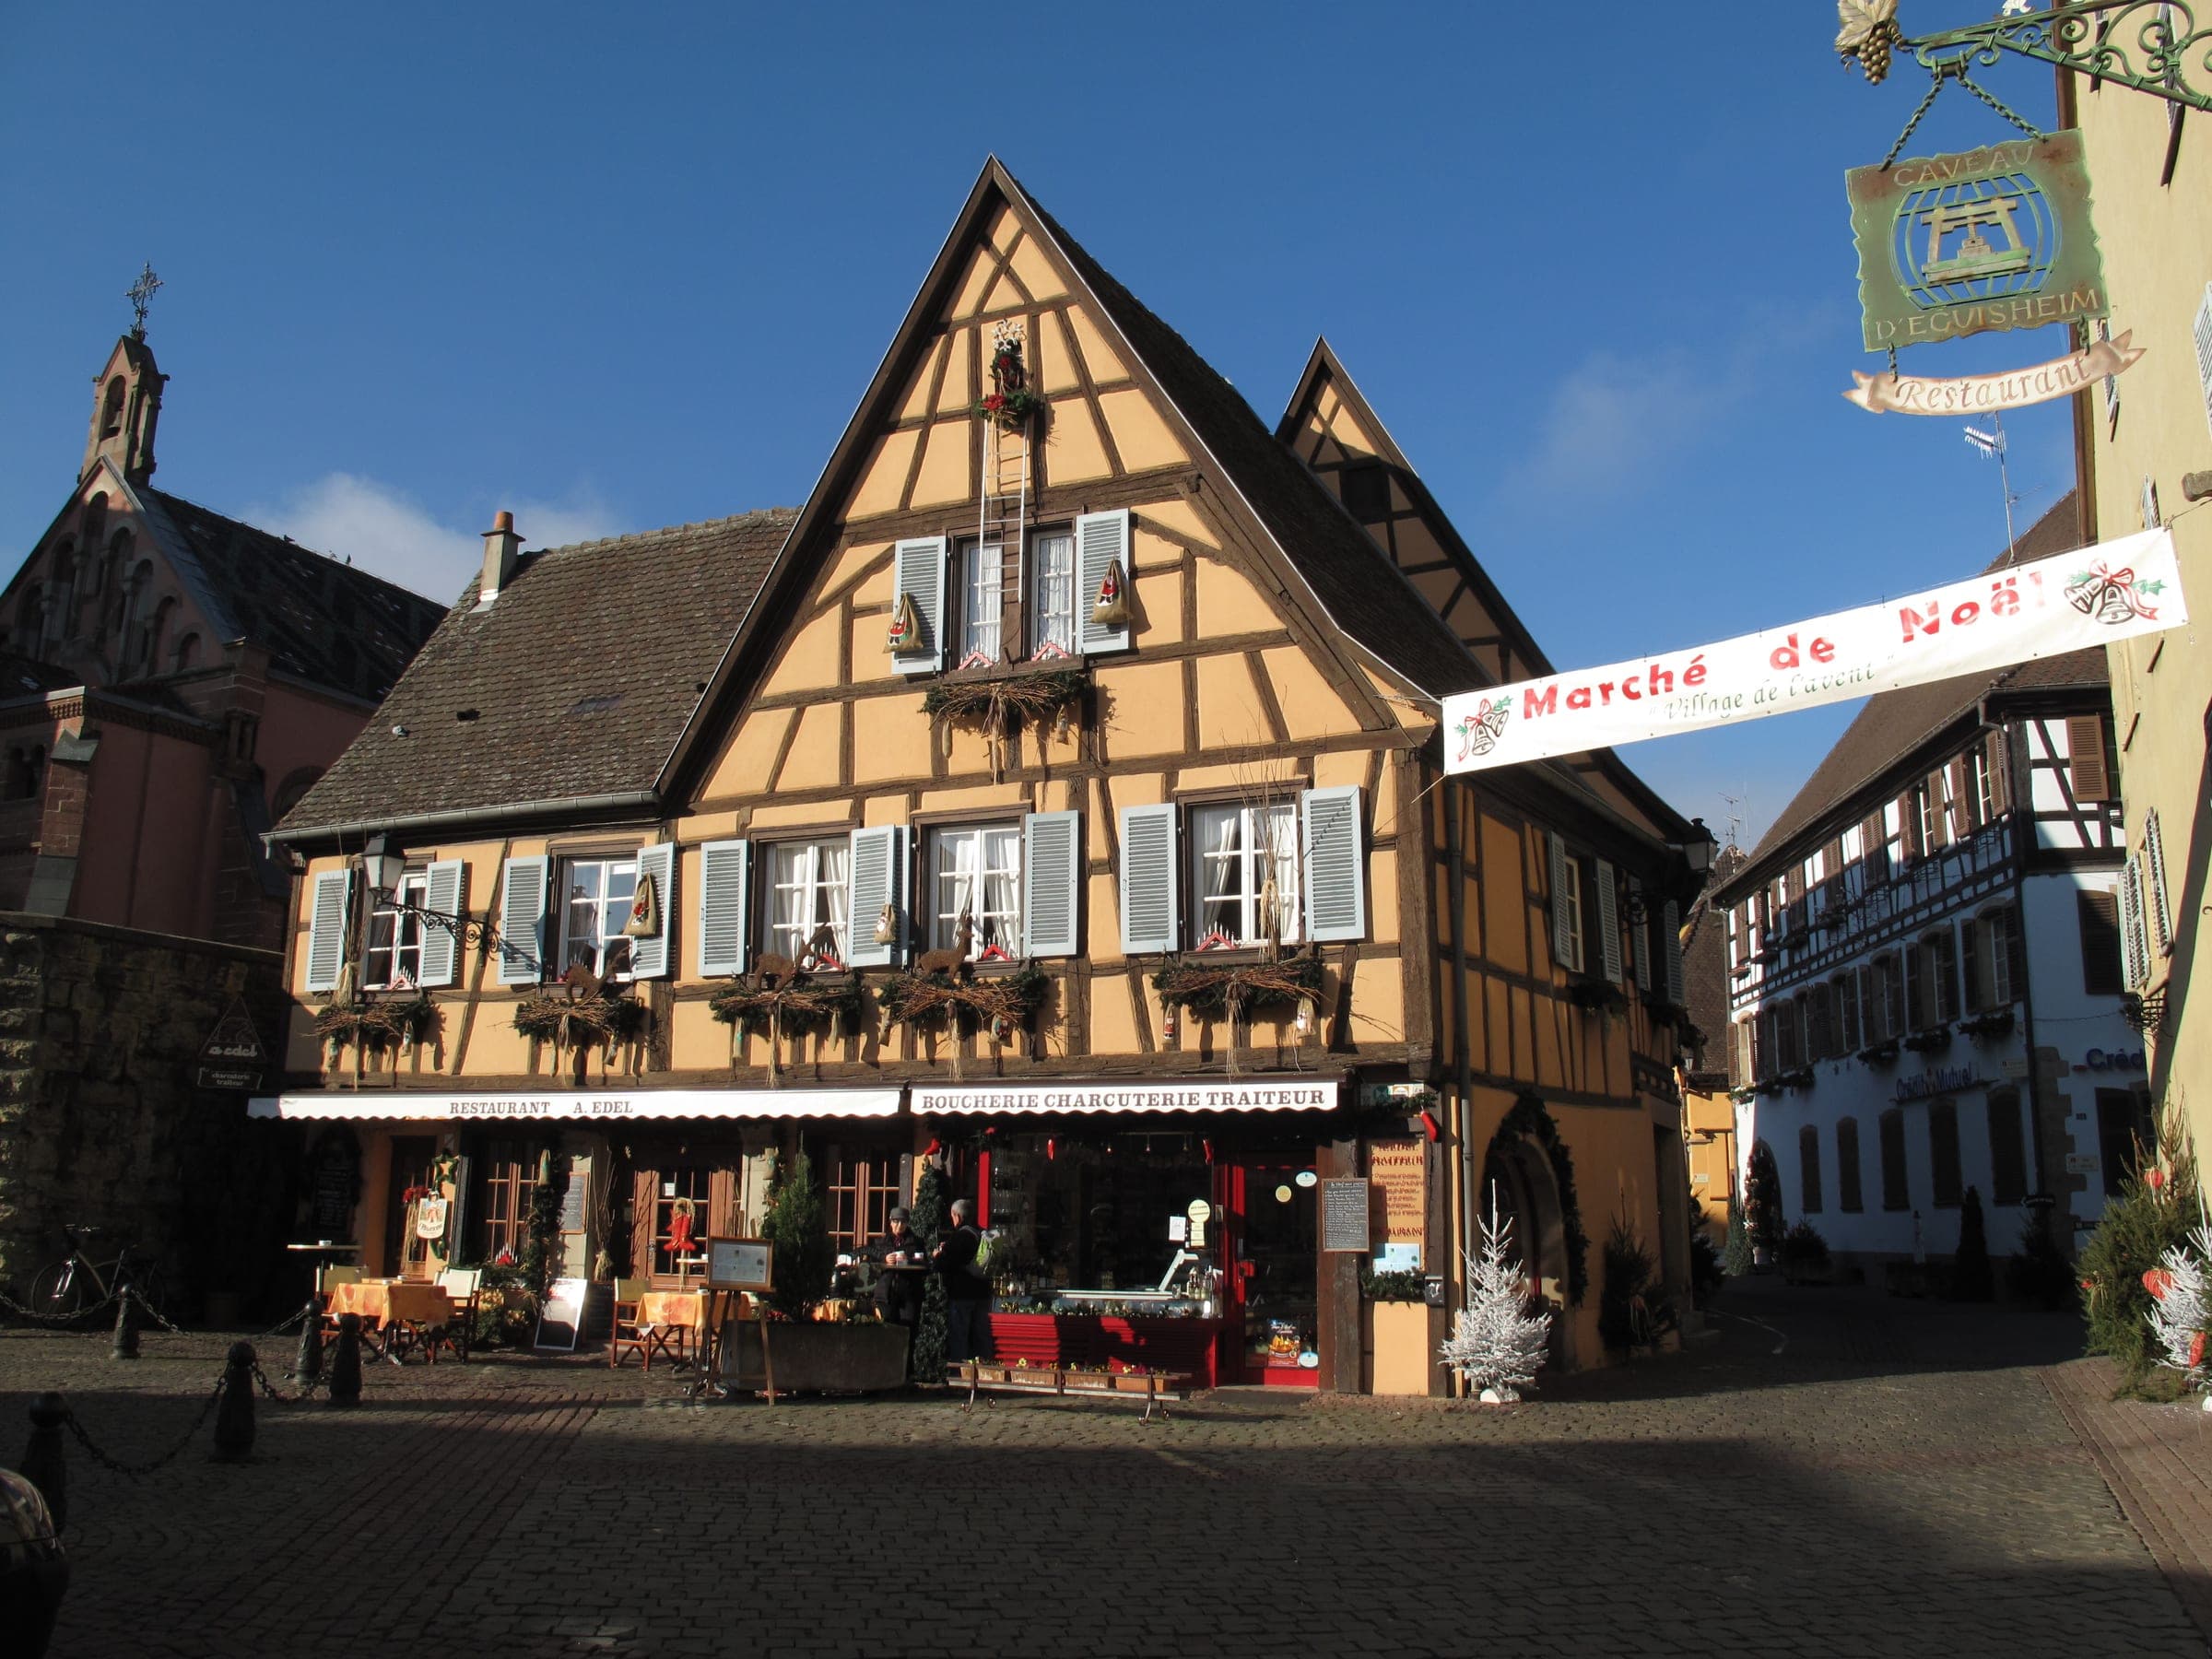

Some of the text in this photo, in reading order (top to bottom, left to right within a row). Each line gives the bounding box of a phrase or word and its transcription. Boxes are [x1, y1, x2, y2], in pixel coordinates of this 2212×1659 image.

[1894, 145, 2033, 186] CAVEAU
[1876, 288, 2100, 340] D'EGUISHEIM
[1894, 356, 2094, 409] Restaurant
[1524, 571, 2047, 720] Marché de Noël
[1754, 679, 1779, 705] de
[1936, 1062, 1973, 1093] Mutuel
[450, 1100, 634, 1114] RESTAURANT A. EDEL
[922, 1089, 1325, 1109] BOUCHERIE CHARCUTERIE TRAITEUR
